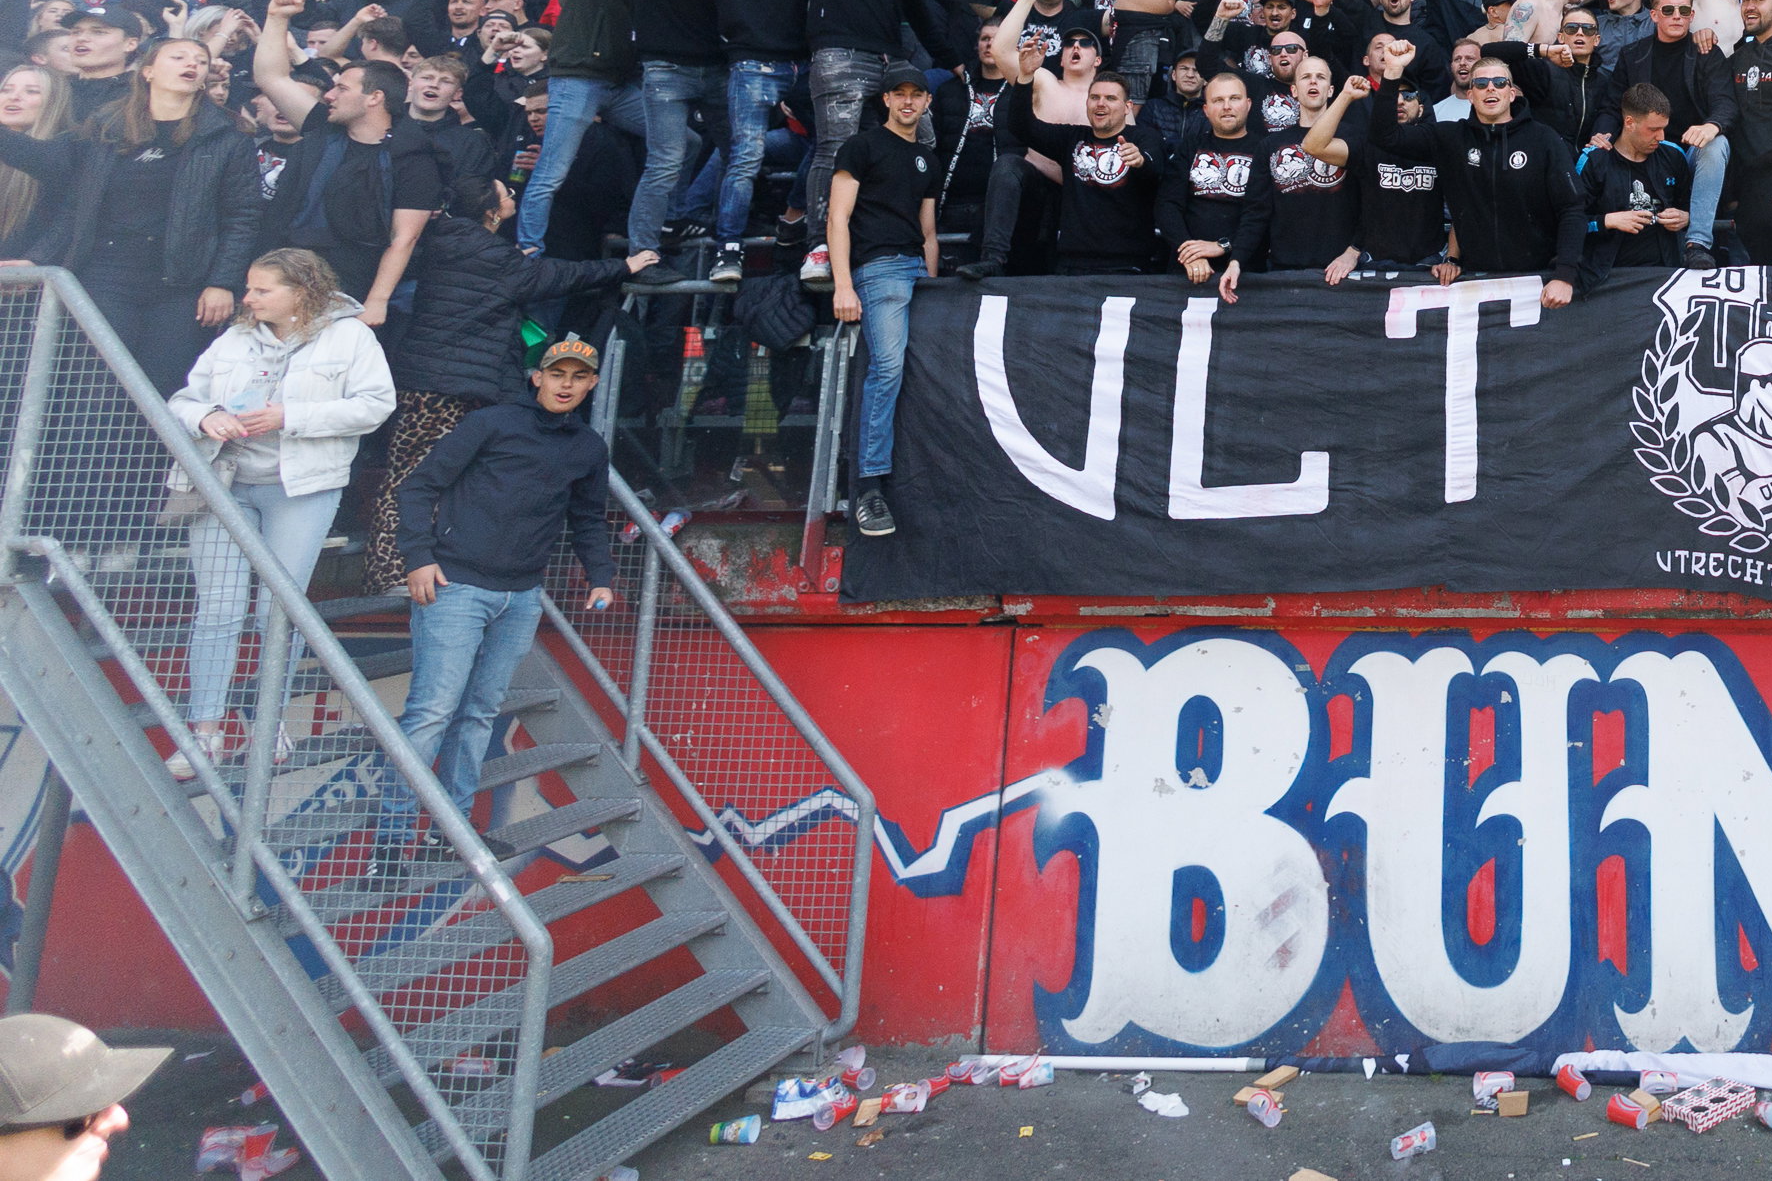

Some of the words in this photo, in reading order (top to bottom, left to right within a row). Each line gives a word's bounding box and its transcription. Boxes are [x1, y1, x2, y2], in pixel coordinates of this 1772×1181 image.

[1310, 172, 1337, 182] UTRECHT
[1382, 172, 1401, 186] 20
[1416, 174, 1433, 188] 19
[1223, 181, 1247, 192] UTRECH
[1701, 265, 1746, 292] 20
[551, 341, 594, 357] ICON
[973, 275, 1544, 521] ULT
